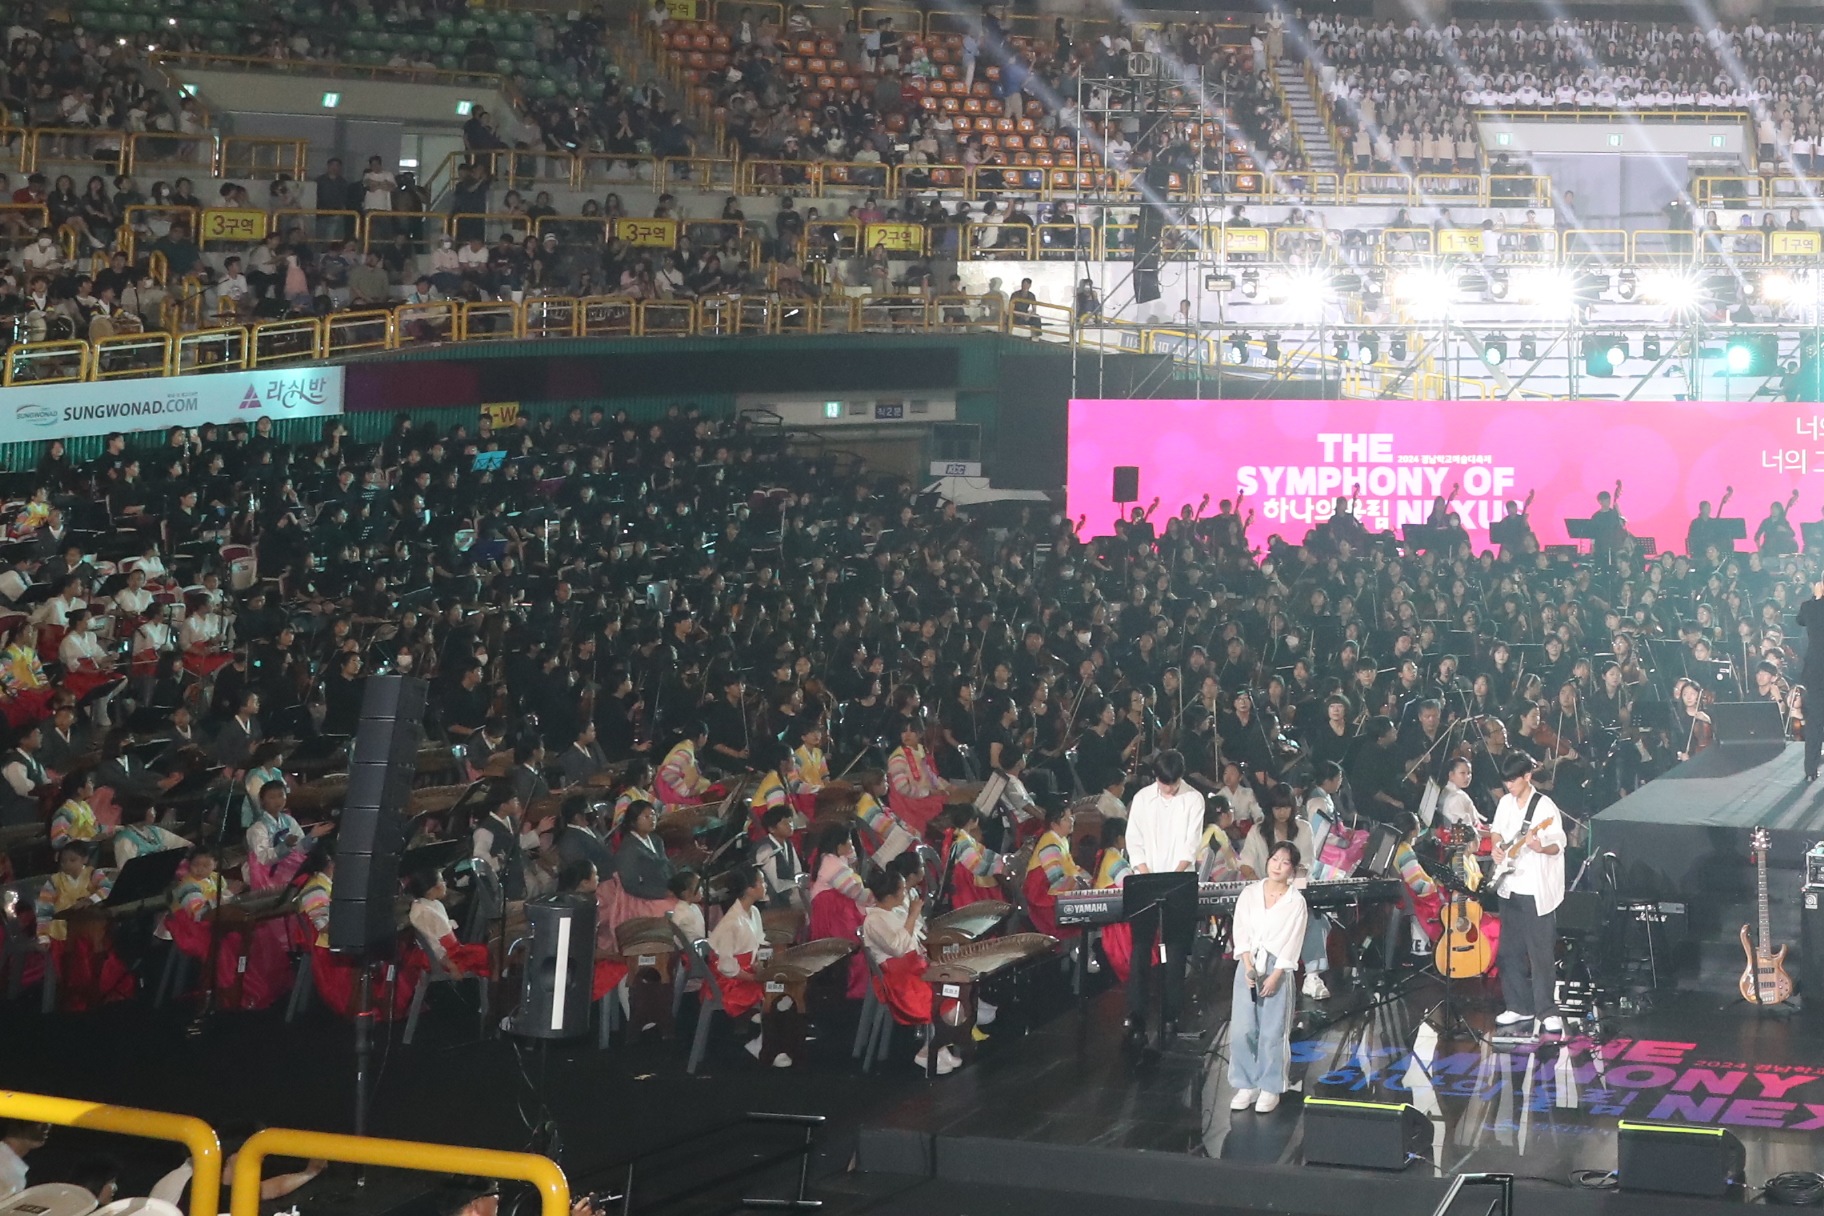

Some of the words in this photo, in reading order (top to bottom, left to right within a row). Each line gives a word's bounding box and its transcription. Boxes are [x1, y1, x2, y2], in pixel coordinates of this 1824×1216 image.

[212, 215, 254, 235] 3구역
[626, 224, 666, 242] 3구역
[877, 229, 914, 247] 2구역
[1781, 236, 1814, 252] 1구역
[63, 397, 199, 422] SUNGWONAD.COM
[1317, 433, 1394, 463] THE
[1397, 454, 1420, 464] 2024
[1762, 448, 1807, 475] 너의
[1236, 466, 1450, 496] SYMPHONY
[1462, 466, 1515, 496] OF
[1264, 497, 1338, 524] 하나의
[1074, 902, 1108, 915] YAMAHA
[1694, 1060, 1748, 1069] 2024
